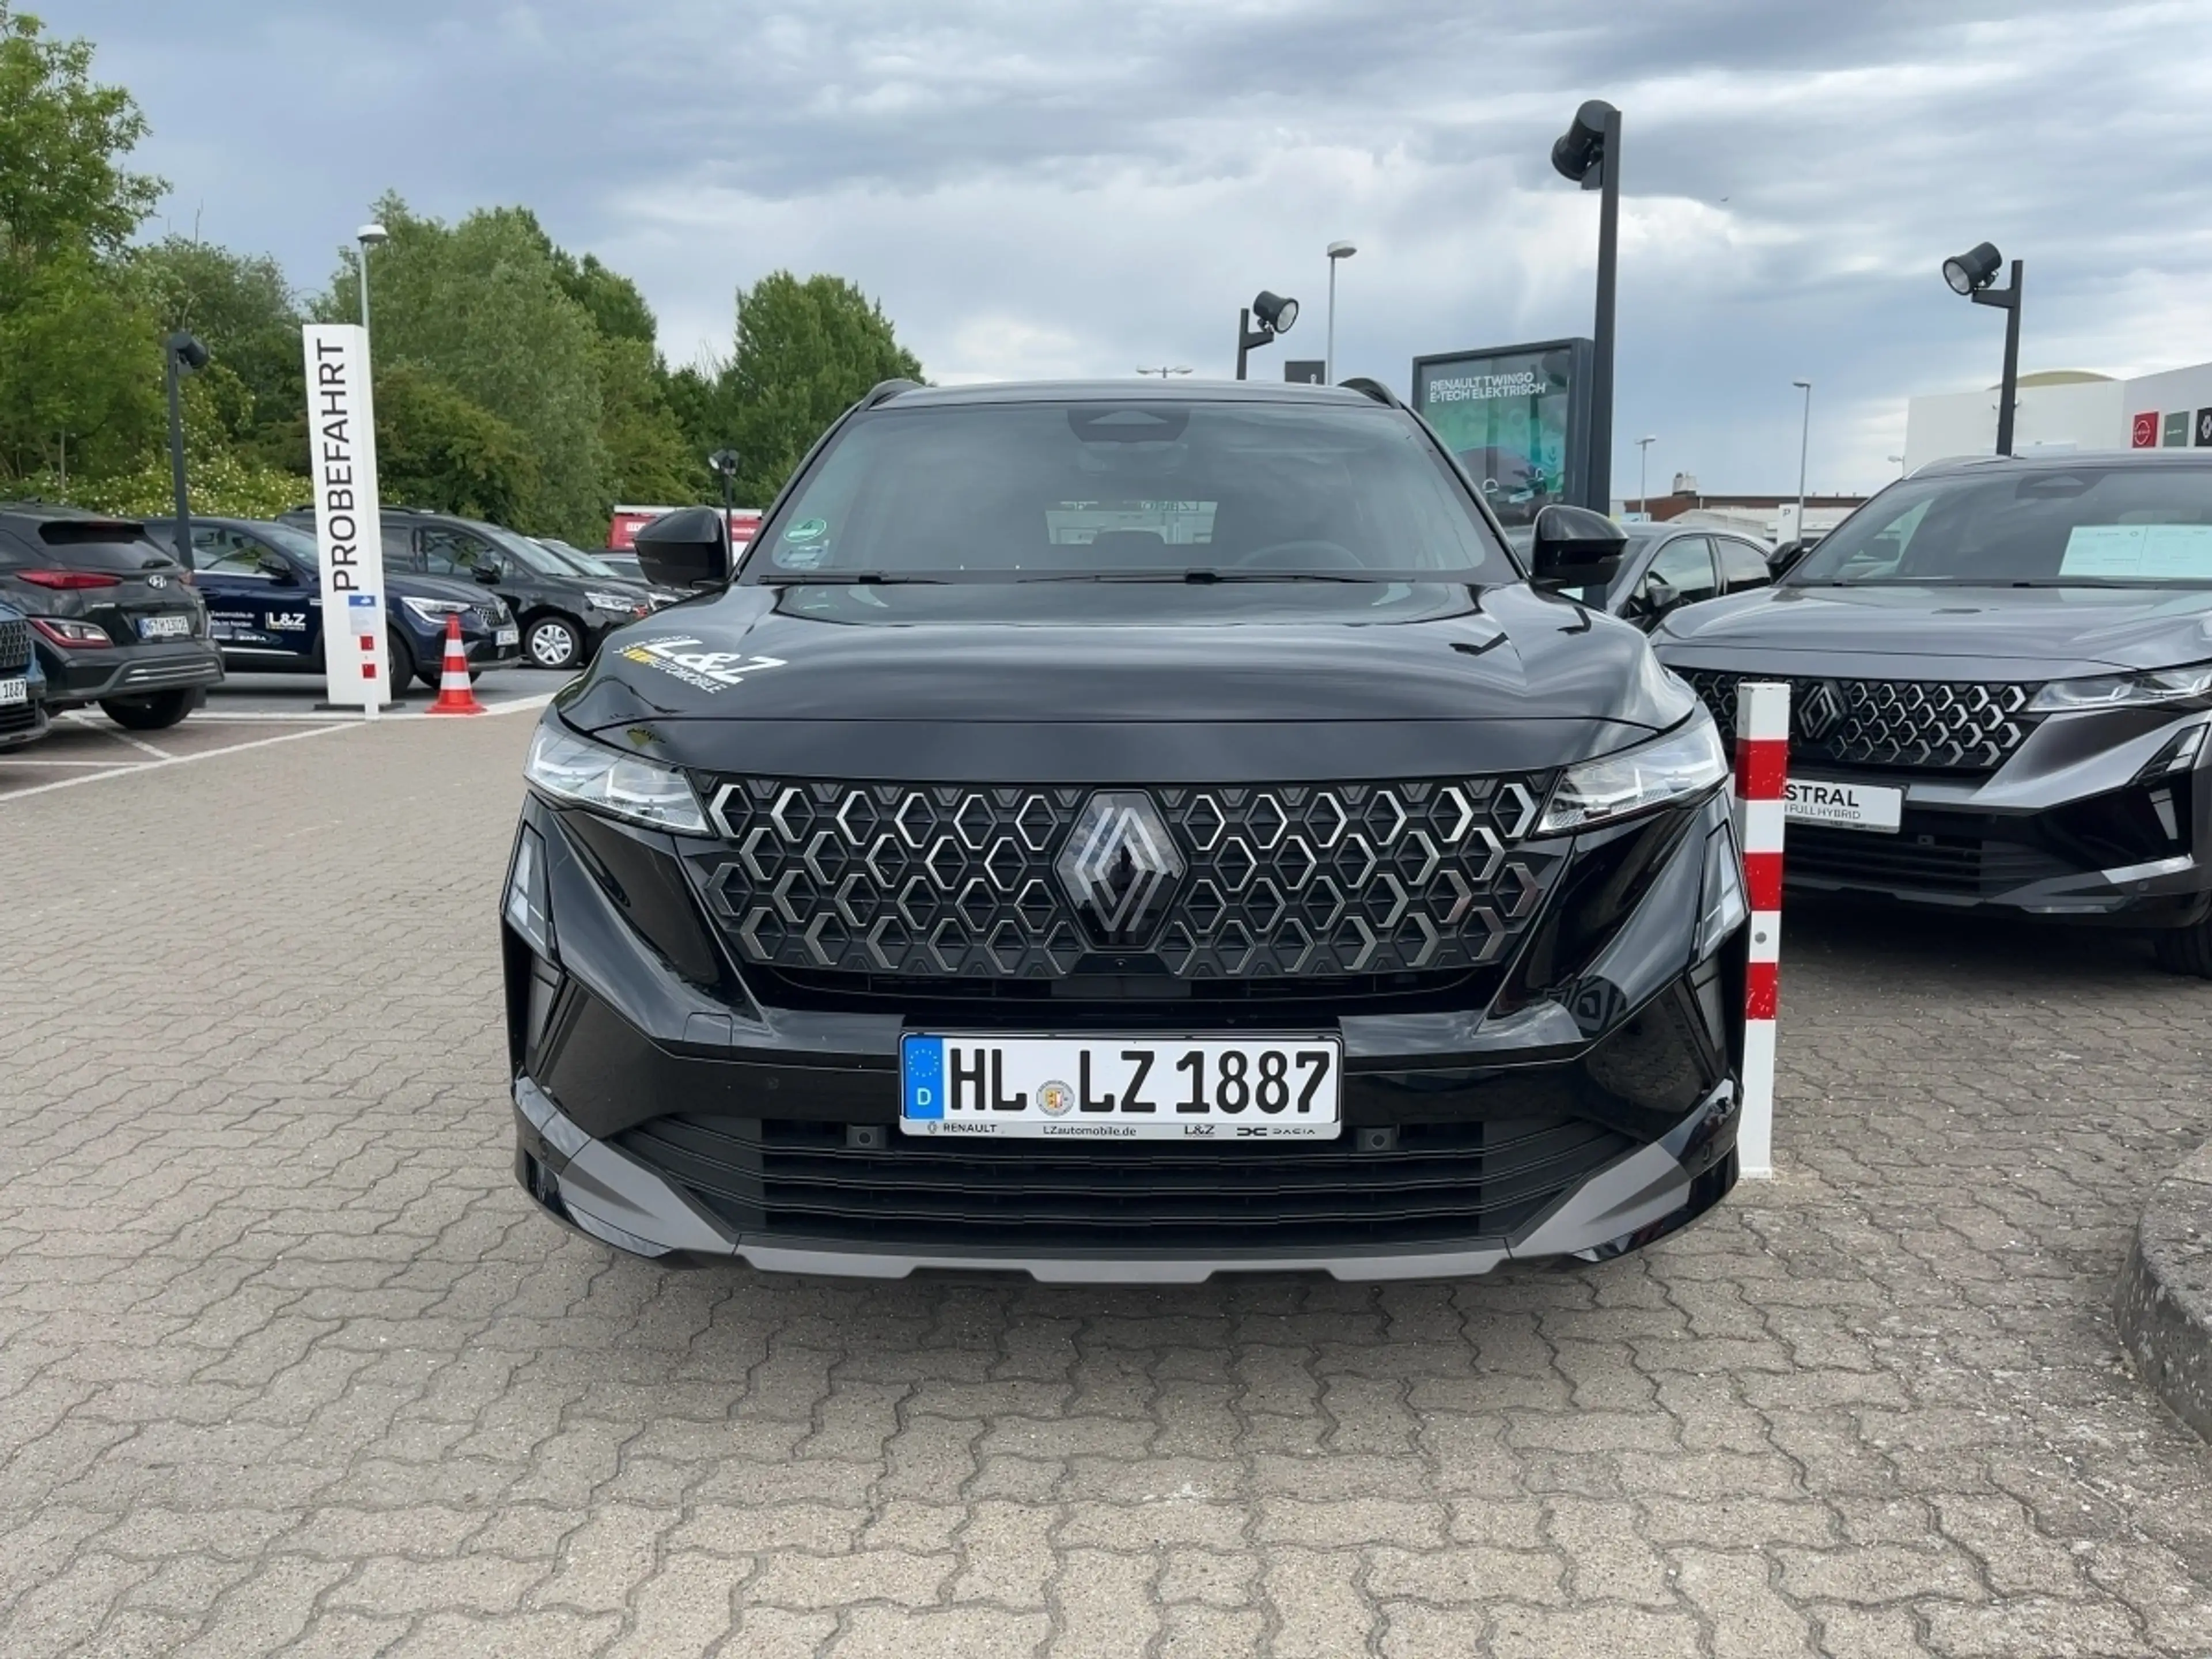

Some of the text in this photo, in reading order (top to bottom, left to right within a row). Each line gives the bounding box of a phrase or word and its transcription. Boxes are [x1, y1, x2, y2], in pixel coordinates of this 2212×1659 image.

[1430, 372, 1534, 392] RENAULT TWINGO
[1430, 382, 1546, 403] E-TECH ELEKTRISCH
[317, 338, 359, 592] PROBEFAHRT
[268, 612, 306, 626] L&Z
[642, 639, 789, 685] L&Z
[1786, 783, 1859, 808] STRAL
[1790, 804, 1816, 816] FULL
[1817, 806, 1861, 820] HYBRID
[950, 1048, 1027, 1111] HL
[1079, 1050, 1156, 1113] LZ
[1176, 1050, 1330, 1115] 1887
[917, 1088, 931, 1105] D
[943, 1124, 998, 1132] RENAULT
[1043, 1126, 1137, 1137] LZautomobile.de
[1184, 1124, 1215, 1135] L&Z
